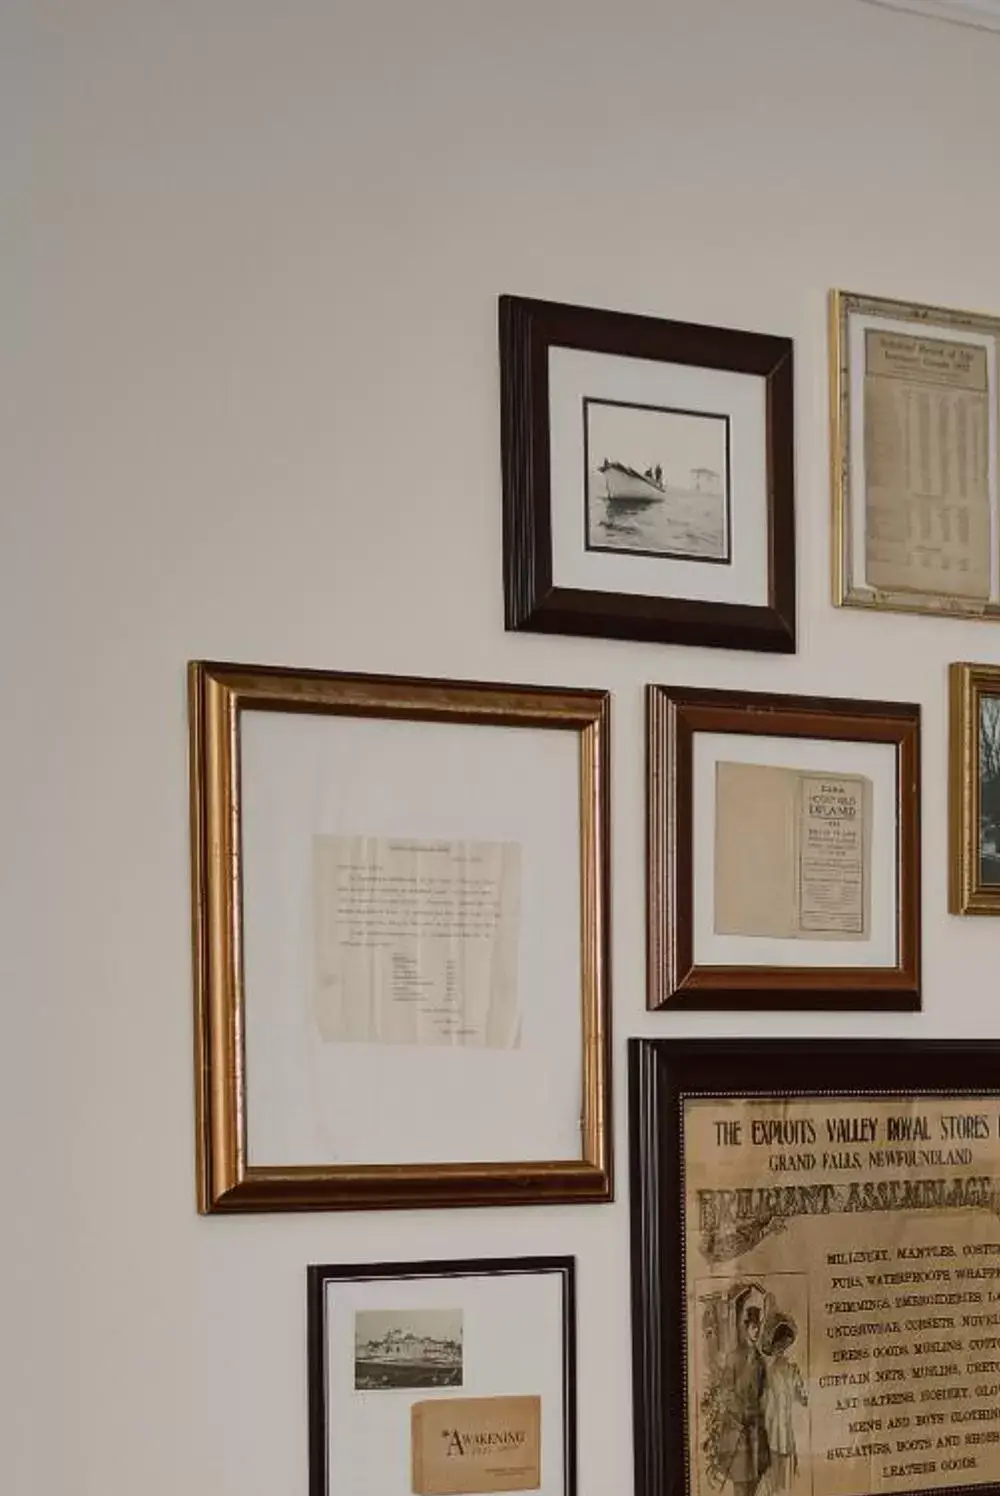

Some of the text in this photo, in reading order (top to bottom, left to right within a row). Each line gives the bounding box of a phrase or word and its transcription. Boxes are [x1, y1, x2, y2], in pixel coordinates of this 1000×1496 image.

[714, 1119, 743, 1147] THE
[752, 1118, 816, 1146] EXPLOITS
[827, 1116, 879, 1143] VALLEY
[886, 1115, 932, 1141] ROYAL
[940, 1113, 990, 1139] STORES
[769, 1152, 816, 1172] GRAND
[868, 1147, 973, 1169] NEWFOUNDLAND
[886, 1415, 911, 1430] AND
[447, 1427, 526, 1457] AWAKENING
[935, 1433, 961, 1449] AND
[964, 1431, 1000, 1447] SHOES
